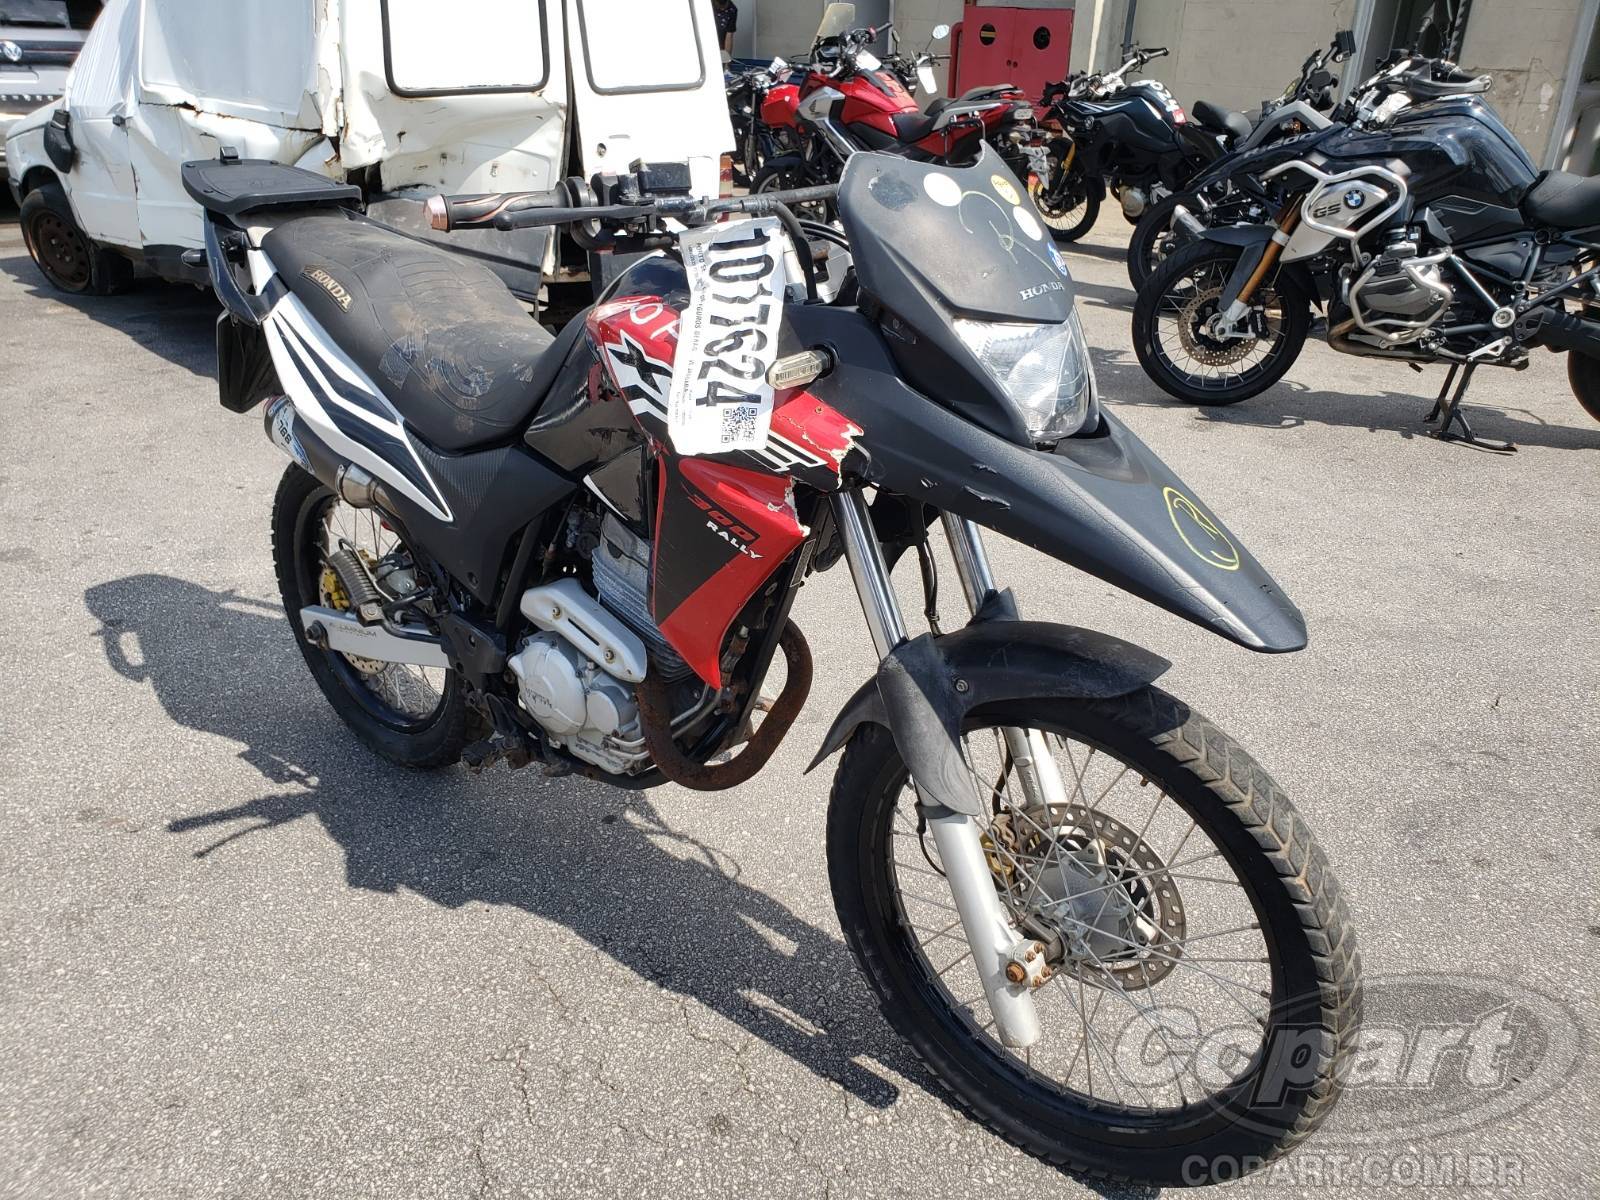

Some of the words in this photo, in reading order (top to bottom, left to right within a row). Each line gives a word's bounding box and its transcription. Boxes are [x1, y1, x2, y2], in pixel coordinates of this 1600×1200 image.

[1312, 203, 1342, 219] GS
[1019, 281, 1065, 300] HONDA
[695, 228, 774, 407] 1017624
[685, 492, 756, 541] 300
[706, 520, 764, 559] RALLY
